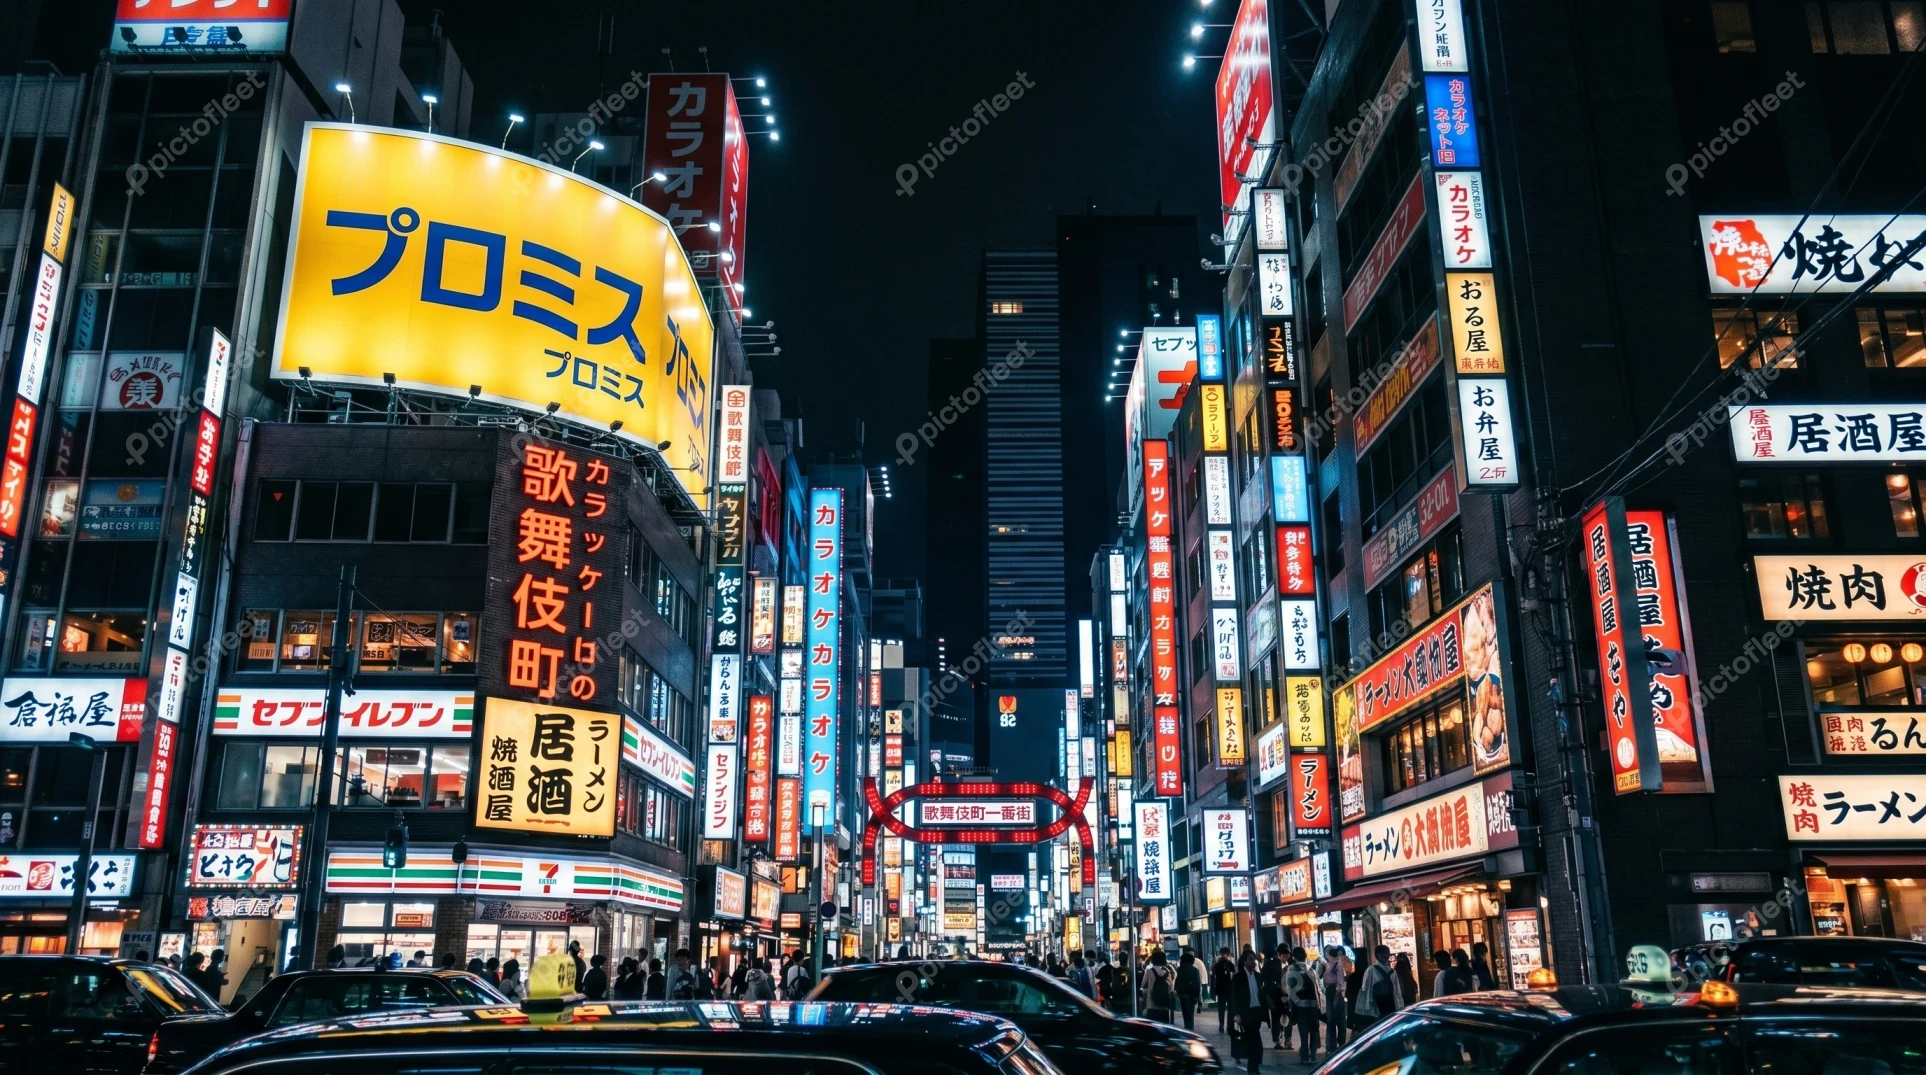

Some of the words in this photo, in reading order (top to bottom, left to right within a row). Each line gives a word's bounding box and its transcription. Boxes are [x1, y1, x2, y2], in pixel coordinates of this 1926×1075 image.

[1449, 79, 1469, 136] カラオケ
[662, 80, 707, 237] カラオケ
[1449, 184, 1477, 265] カラオケ
[325, 206, 646, 365] プロミス
[1459, 279, 1491, 353] おる屋
[544, 348, 645, 408] プロミス
[666, 313, 705, 443] プロミス
[1472, 385, 1504, 461] お弁屋
[1786, 411, 1926, 454] 居酒屋
[509, 444, 578, 700] 歌舞伎町
[1785, 563, 1888, 612] 焼肉
[525, 712, 576, 818] 居酒
[581, 718, 610, 815] ラーメン
[1299, 758, 1323, 820] ラーメン
[1788, 781, 1821, 834] 焼肉
[1823, 790, 1926, 826] ラーメン
[1365, 826, 1400, 865] ラーメン
